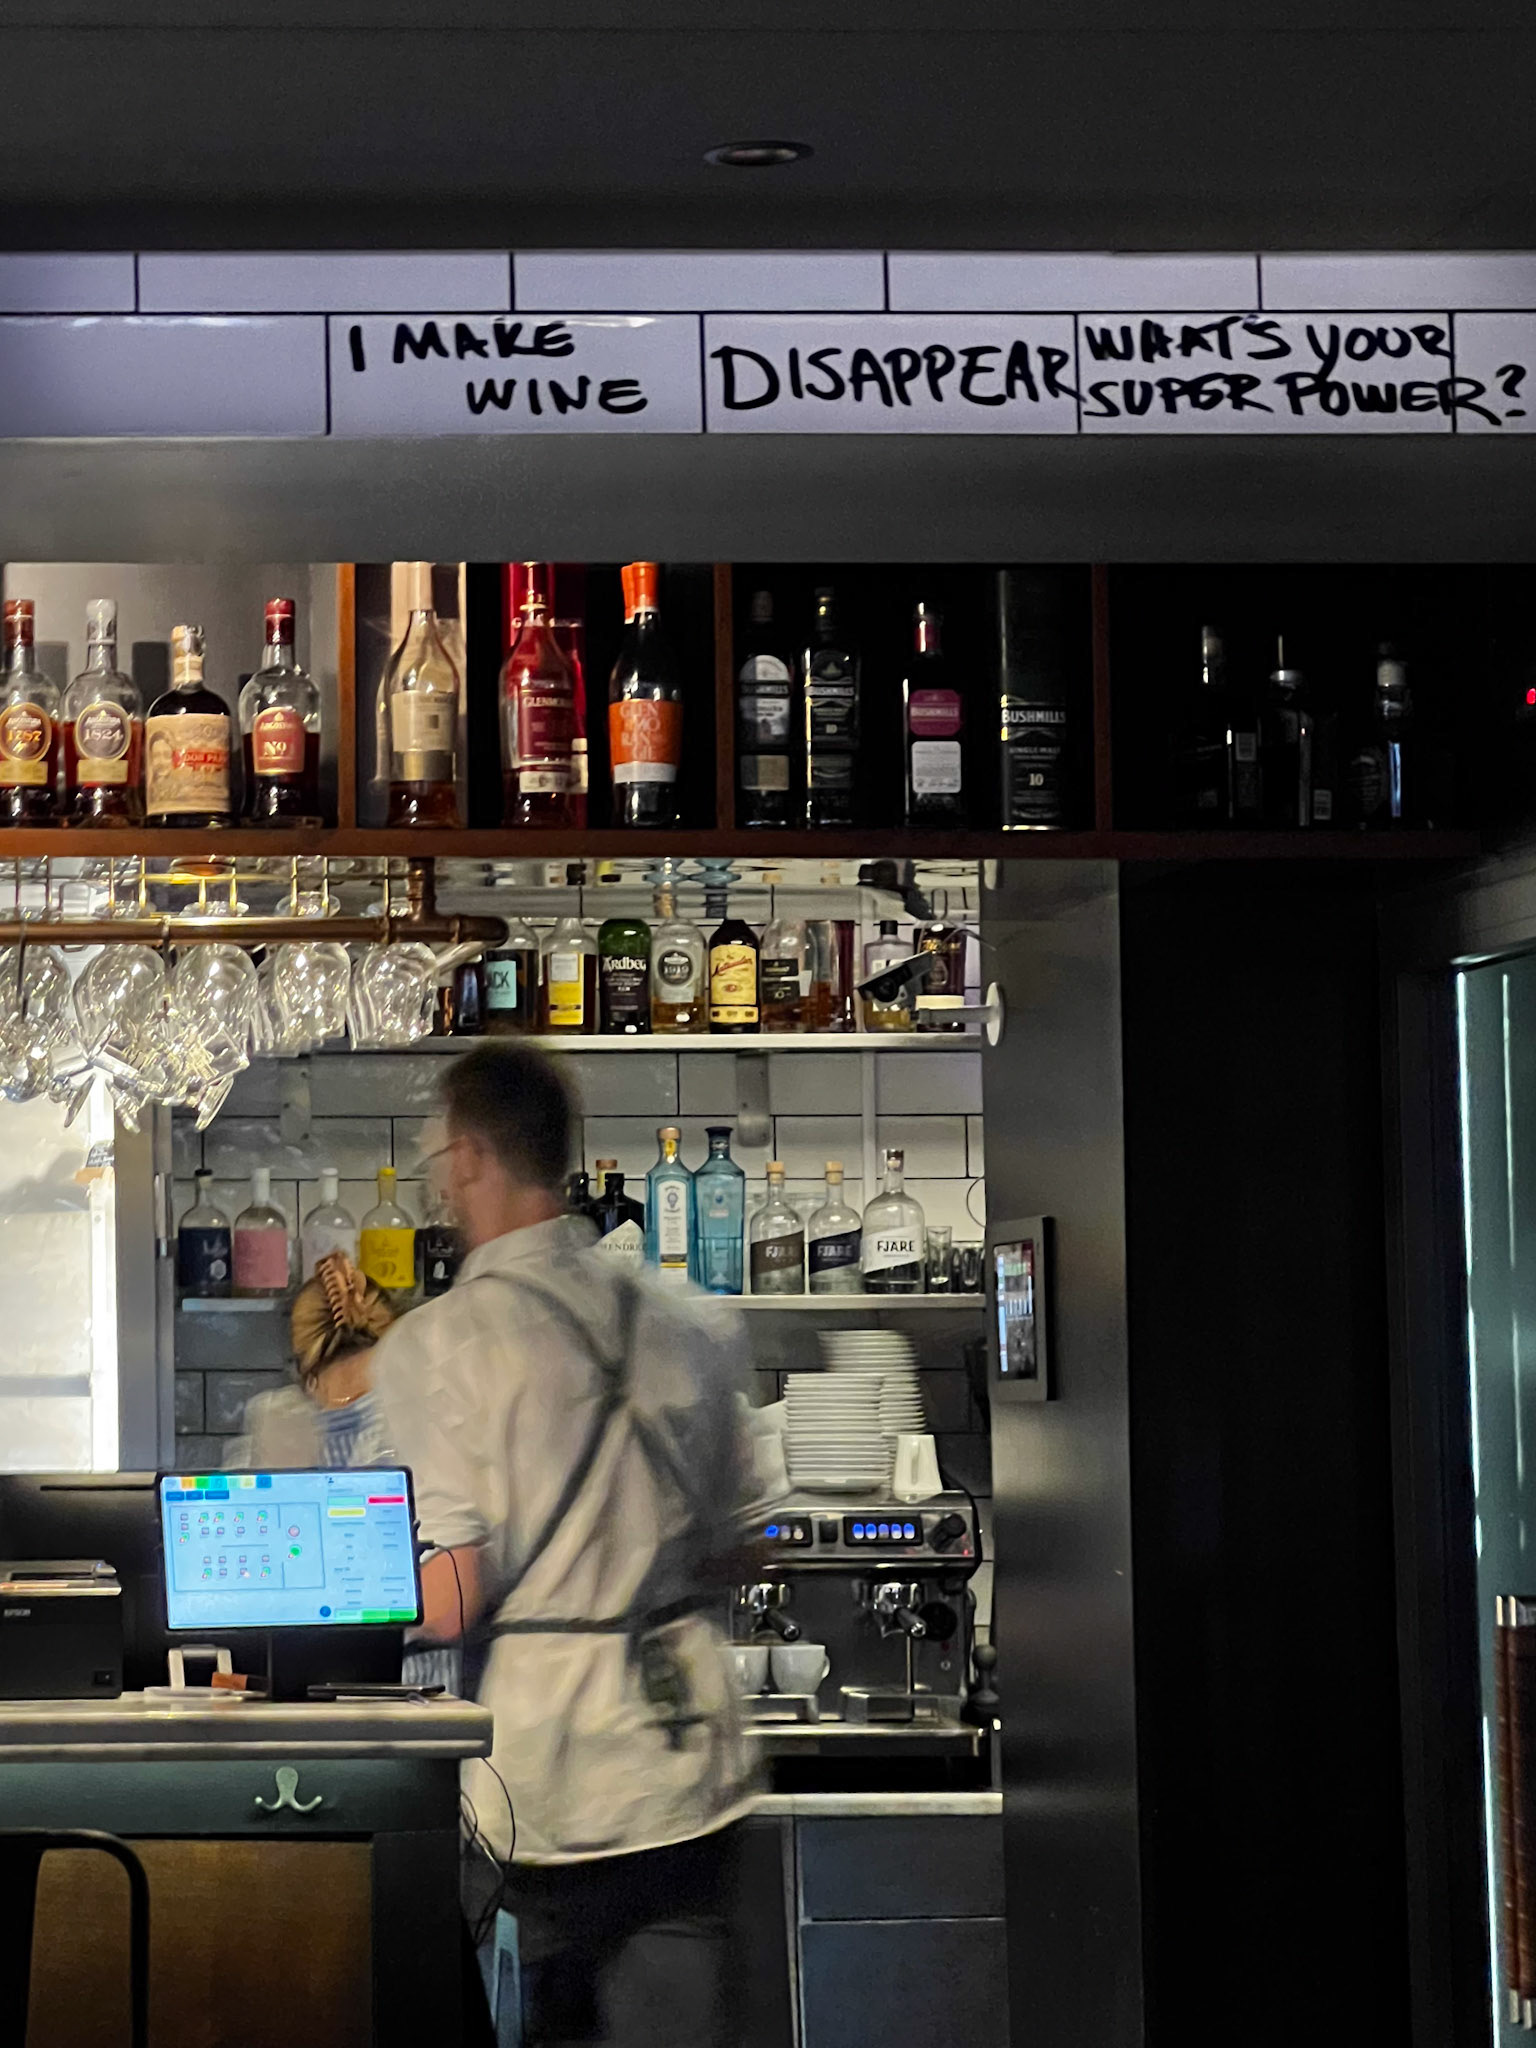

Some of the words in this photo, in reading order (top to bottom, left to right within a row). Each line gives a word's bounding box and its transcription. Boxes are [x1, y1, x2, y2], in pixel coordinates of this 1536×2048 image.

[349, 325, 365, 371] I
[393, 321, 575, 363] MAKE
[466, 375, 648, 414] WINE
[711, 341, 1087, 410] DISAPPEAR
[1084, 374, 1275, 417] SUPER
[1274, 364, 1527, 426] POWER?
[1001, 709, 1065, 723] BUSHMILLS
[1029, 773, 1044, 786] 10
